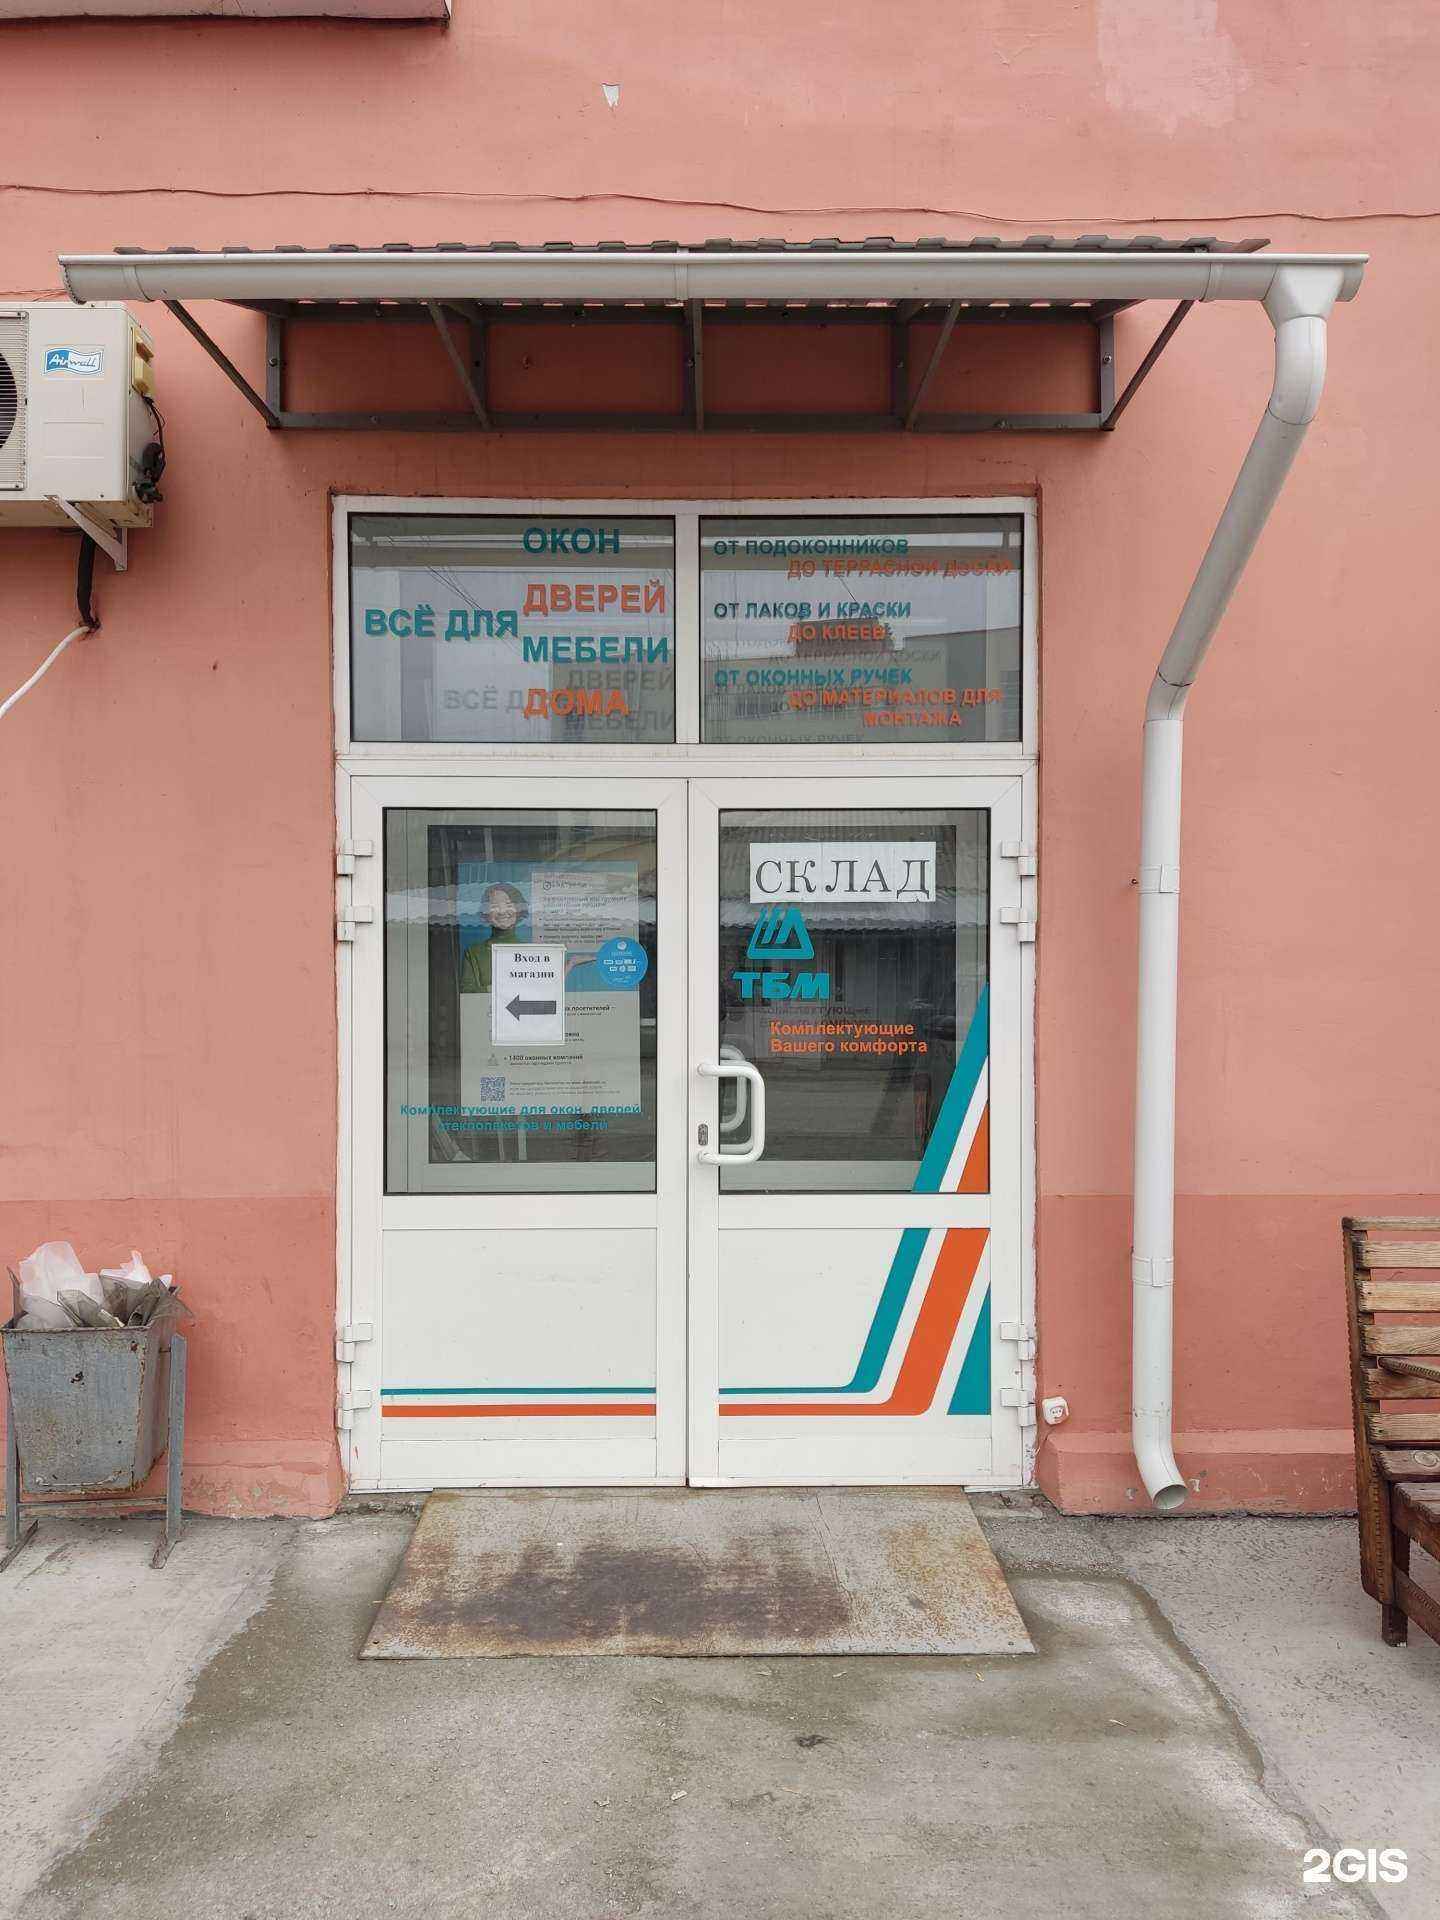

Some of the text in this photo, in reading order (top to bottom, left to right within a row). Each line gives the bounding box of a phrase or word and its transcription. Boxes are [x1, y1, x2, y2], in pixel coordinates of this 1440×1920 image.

[522, 527, 620, 554] ОКОН
[713, 539, 909, 556] ОТ ПОДОКОННИКОВ
[787, 560, 816, 580] ДО
[522, 579, 666, 616] ДВЕРЕЙ
[714, 602, 911, 619] ОТ ЛАКОВ И КРАСКИ
[364, 603, 519, 641] ВСЁ ДЛЯ
[787, 624, 886, 643] ДО КЛЕЕВ
[522, 636, 668, 664] МЕБЕЛИ
[714, 668, 912, 687] ОТ ОКОННЫХ РУЧЕК
[522, 688, 631, 720] ДОМА
[822, 688, 957, 706] МАТЕРИАЛОВ
[960, 688, 1004, 706] ДЛЯ
[755, 859, 931, 900] СКЛАД
[514, 953, 540, 963] Вход
[510, 971, 554, 979] магазин
[732, 971, 830, 1000] ТБМ
[770, 1022, 916, 1038] Комплектующие
[770, 1038, 928, 1056] Вашего комфорта
[400, 1104, 516, 1117] Комплектующие
[520, 1105, 546, 1116] для
[590, 1104, 641, 1115] дверей
[557, 1120, 609, 1130] мебели
